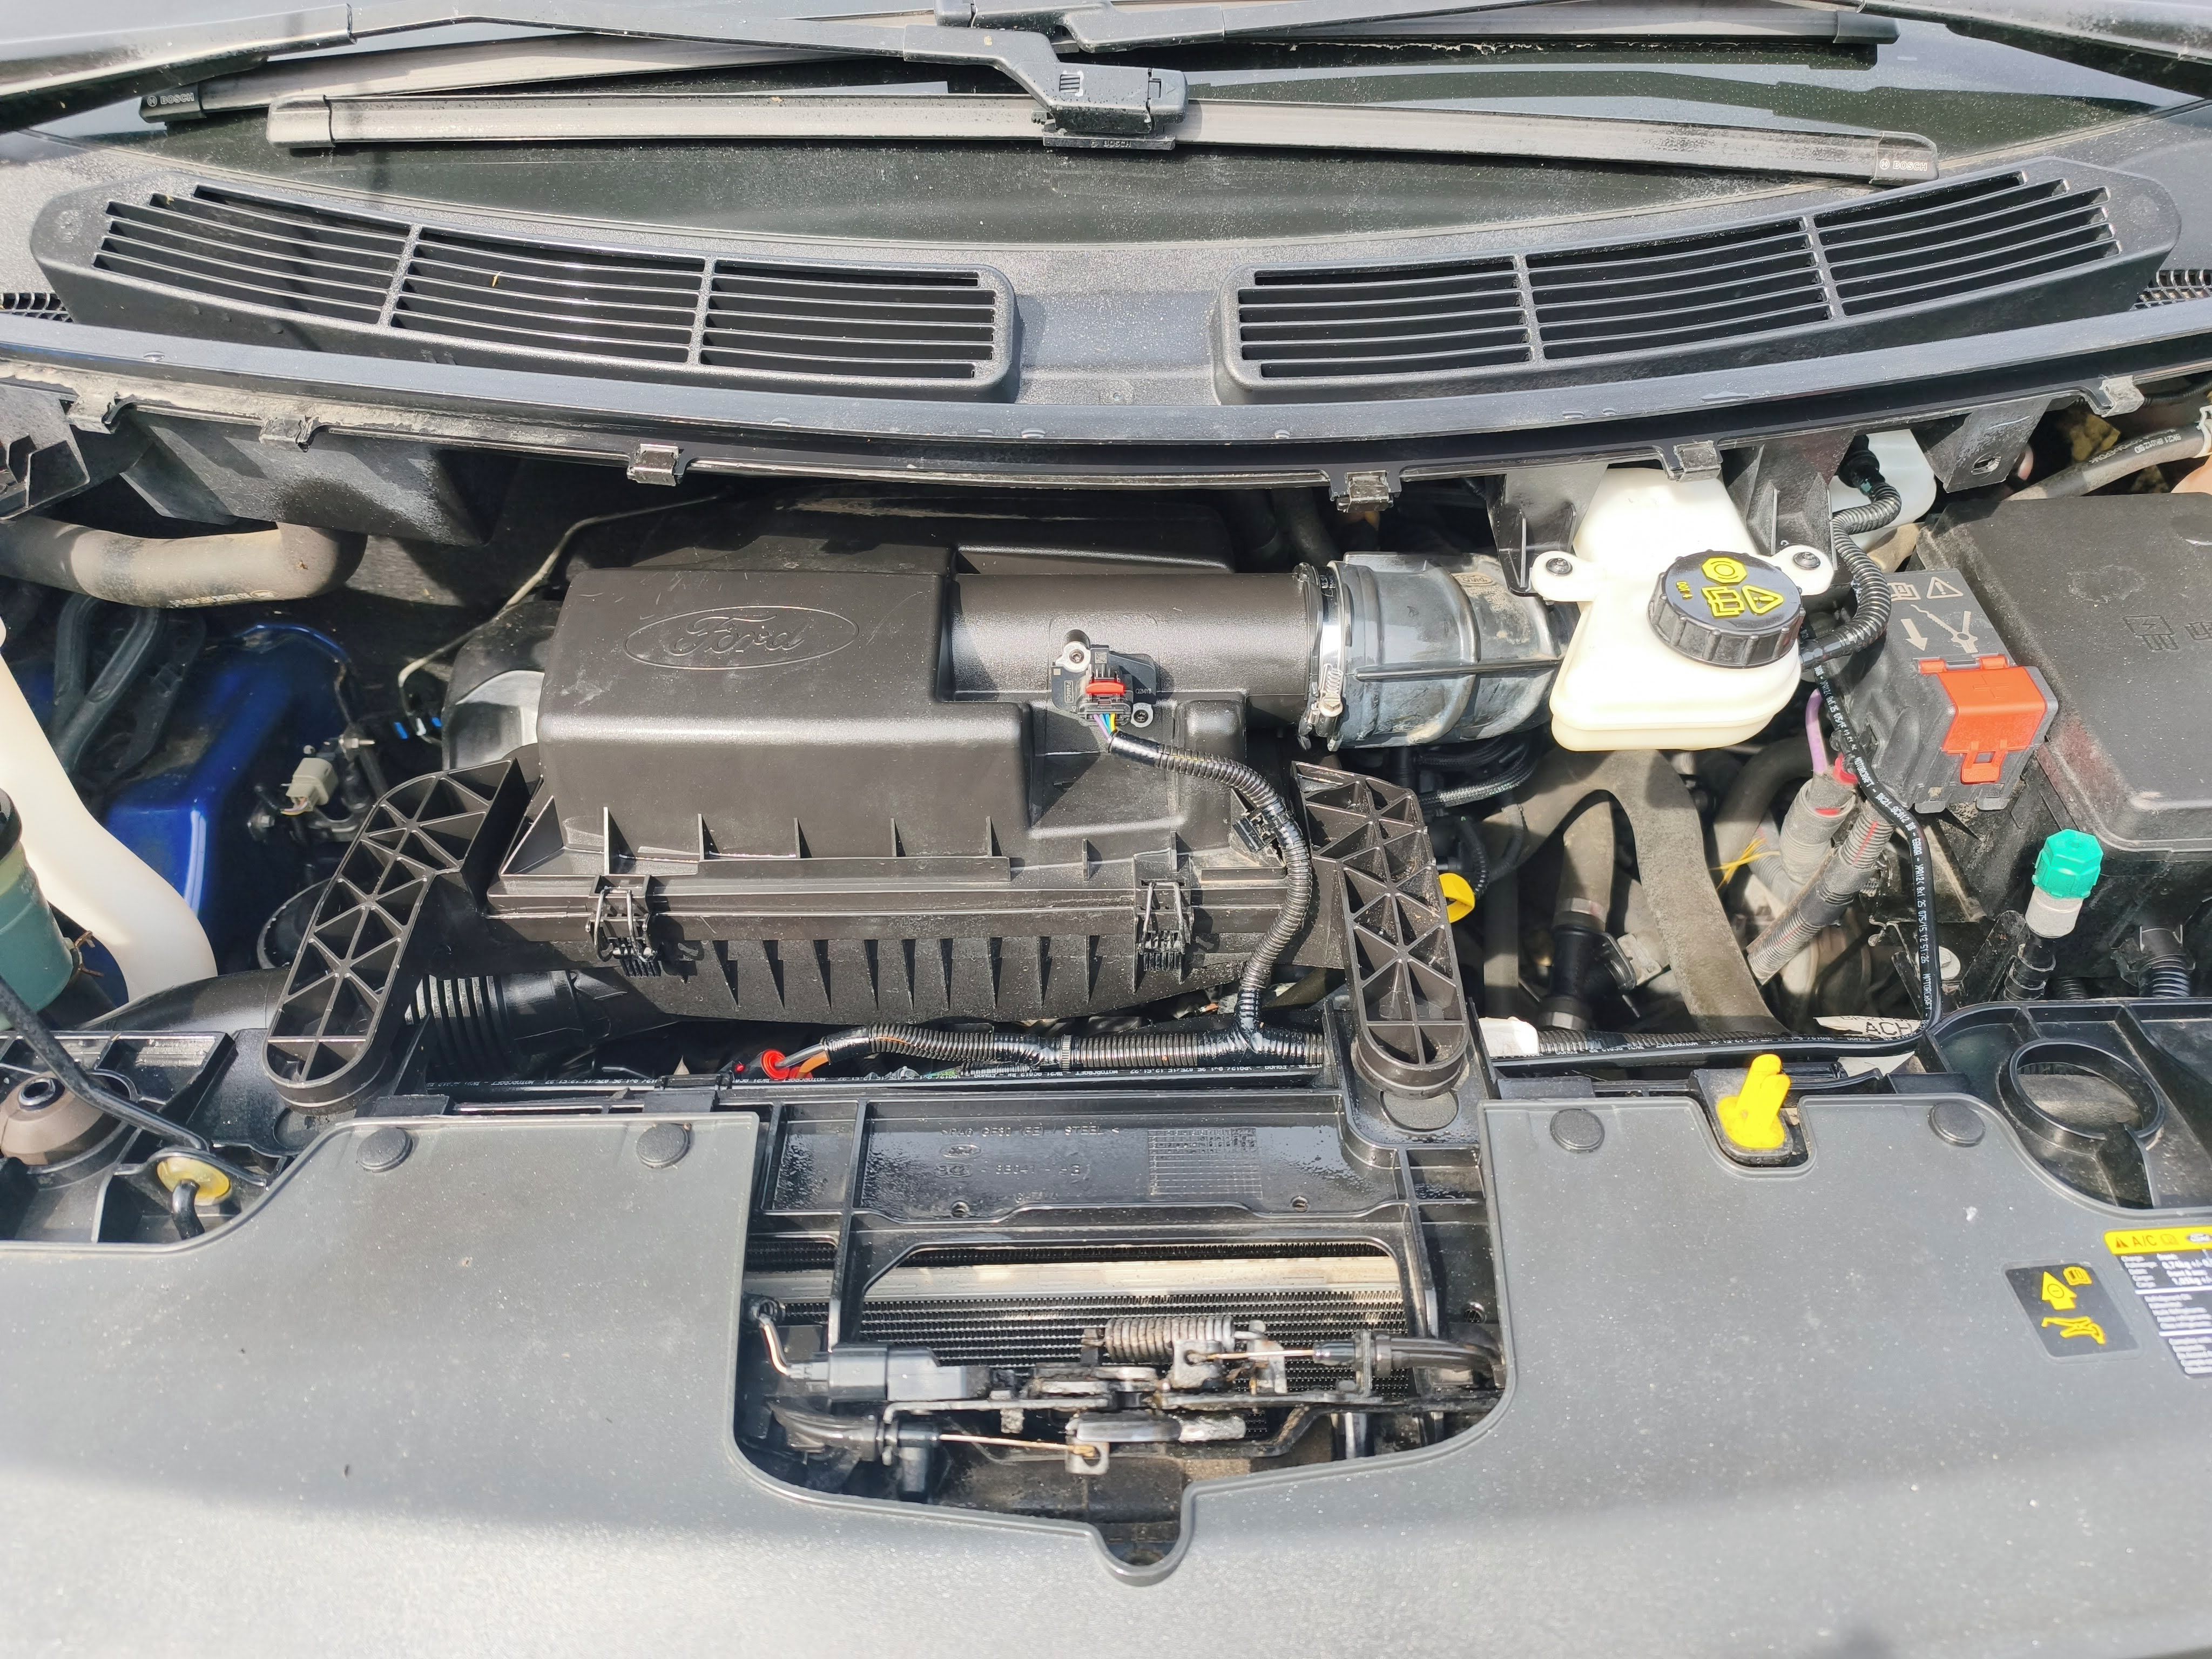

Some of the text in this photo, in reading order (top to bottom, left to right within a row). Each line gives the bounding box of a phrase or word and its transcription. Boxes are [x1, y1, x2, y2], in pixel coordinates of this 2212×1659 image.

[160, 92, 194, 105] BOSCH
[1893, 161, 1927, 171] BOSCH
[669, 614, 806, 657] Ford
[1854, 757, 1874, 787] MOTORCRAFT
[1922, 973, 1932, 1010] MOTORCRAFT
[1865, 1021, 1912, 1036] ACH
[1064, 1125, 1104, 1135] STEEL
[2132, 1235, 2157, 1247] A/C
